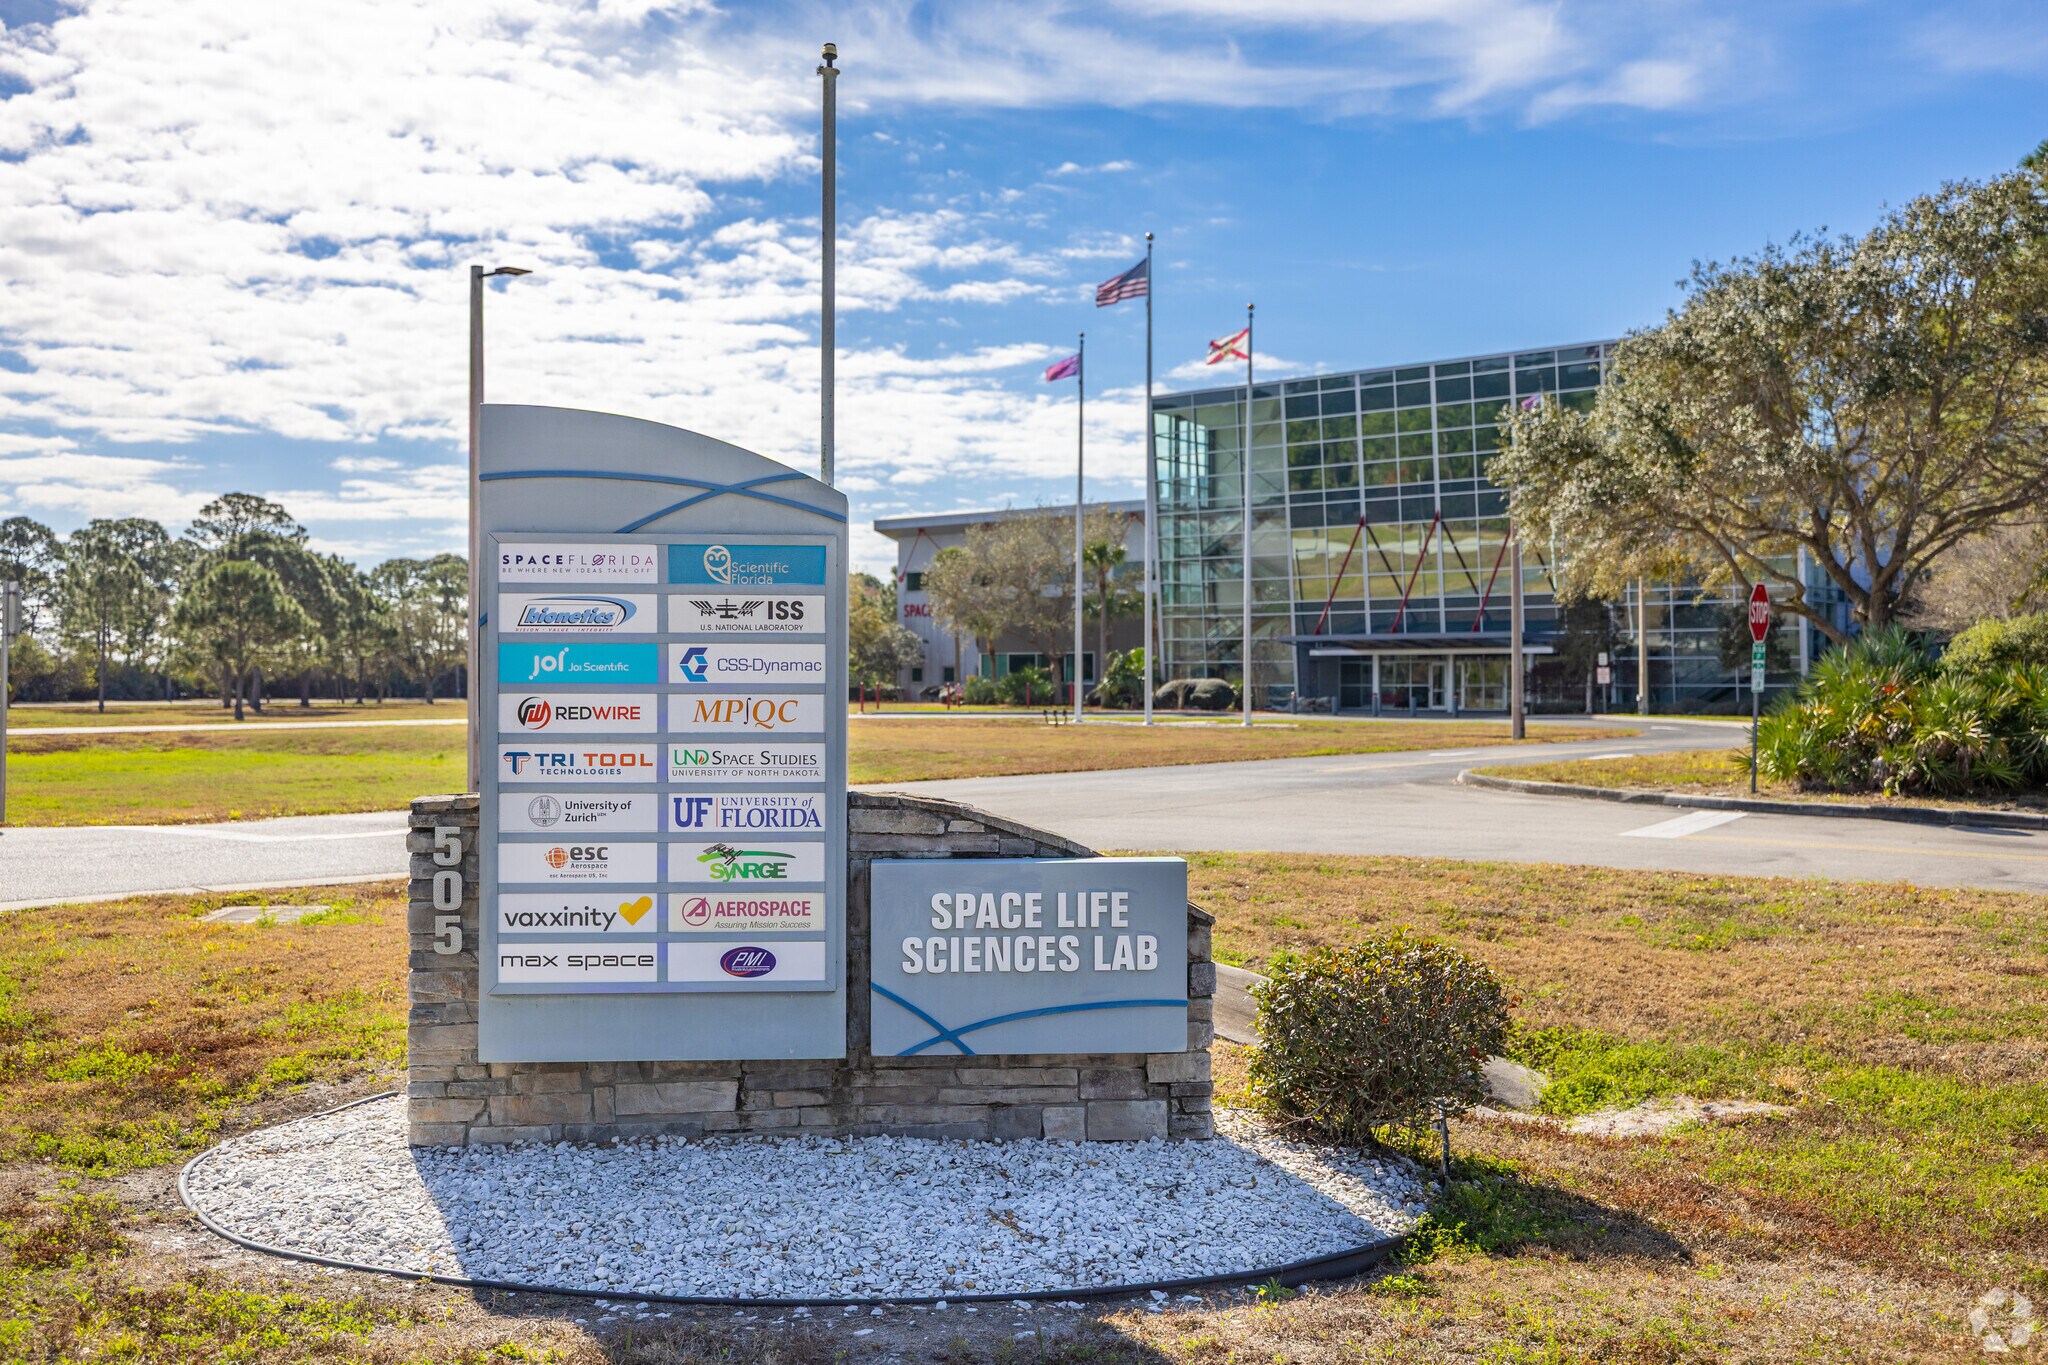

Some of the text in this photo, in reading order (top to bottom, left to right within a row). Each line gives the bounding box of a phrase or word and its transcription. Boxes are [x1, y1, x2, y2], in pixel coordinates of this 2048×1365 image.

[731, 562, 789, 573] Scientific
[731, 573, 773, 584] Florida
[524, 607, 615, 624] bionetics
[768, 601, 804, 619] ISS
[1751, 602, 1768, 624] STOP
[584, 662, 629, 672] Scientific
[717, 658, 822, 674] CSS-Dynamac
[556, 706, 640, 720] REDWIRE
[535, 754, 653, 767] TRI TOOL
[712, 751, 755, 765] SPACE
[760, 751, 817, 765] STUDIES
[565, 801, 632, 812] University of
[722, 797, 813, 810] UNIVERSITY of
[674, 798, 713, 828] UF
[721, 808, 822, 828] FLORIDA
[570, 846, 608, 860] esc
[715, 900, 811, 917] AEROSPACE
[931, 891, 1129, 929] SPACE LIFE
[505, 906, 616, 931] vaxxinity
[715, 921, 748, 930] Assuring
[779, 921, 811, 929] Success
[732, 952, 767, 966] PMI
[902, 935, 1158, 973] SCIENCES LAB
[501, 954, 654, 970] max space
